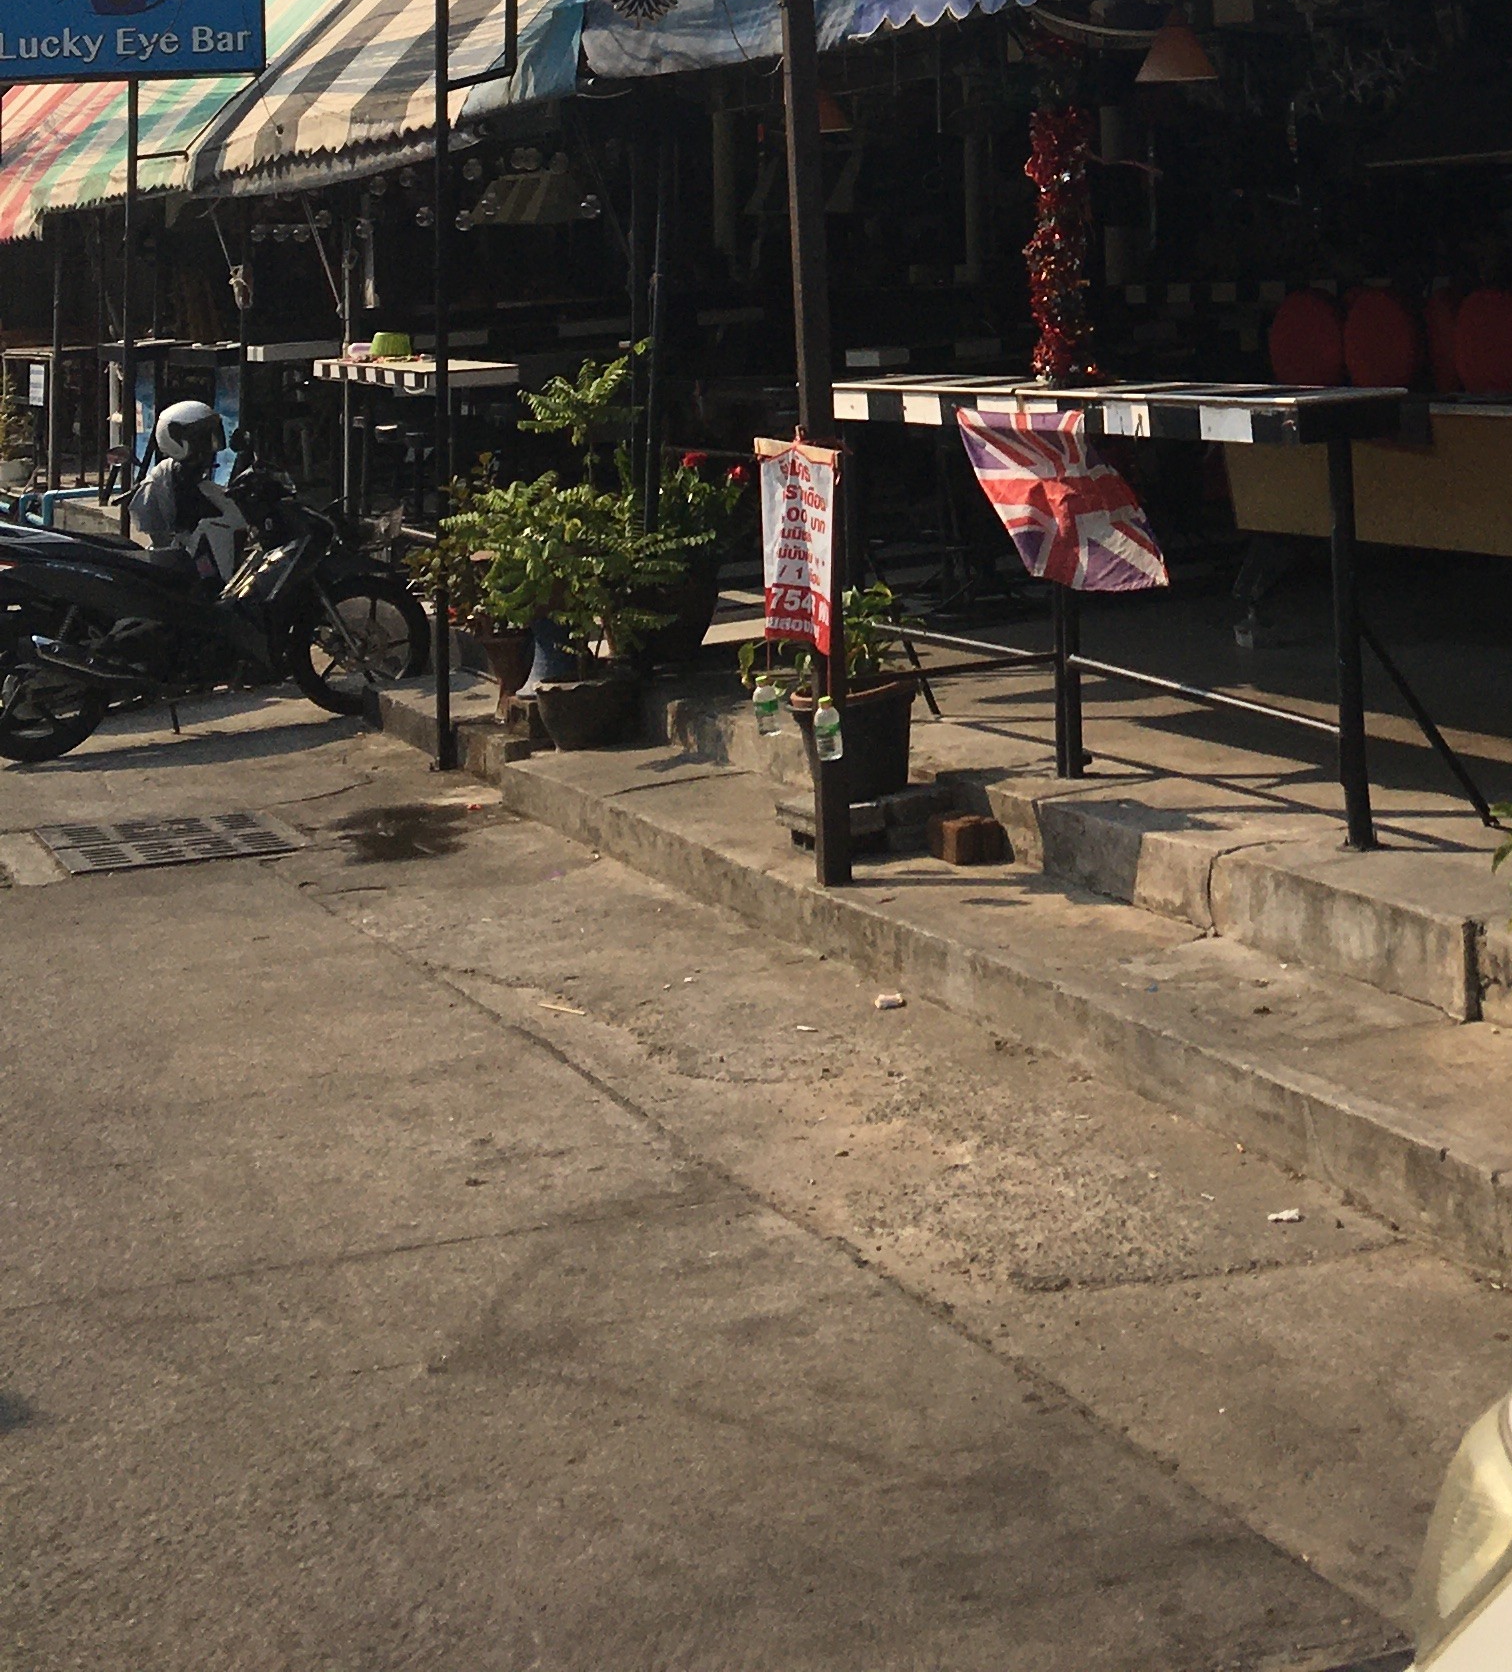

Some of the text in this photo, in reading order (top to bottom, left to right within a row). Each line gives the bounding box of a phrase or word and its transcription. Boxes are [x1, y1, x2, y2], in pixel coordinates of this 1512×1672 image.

[0, 25, 252, 63] Lucky Eye Bar
